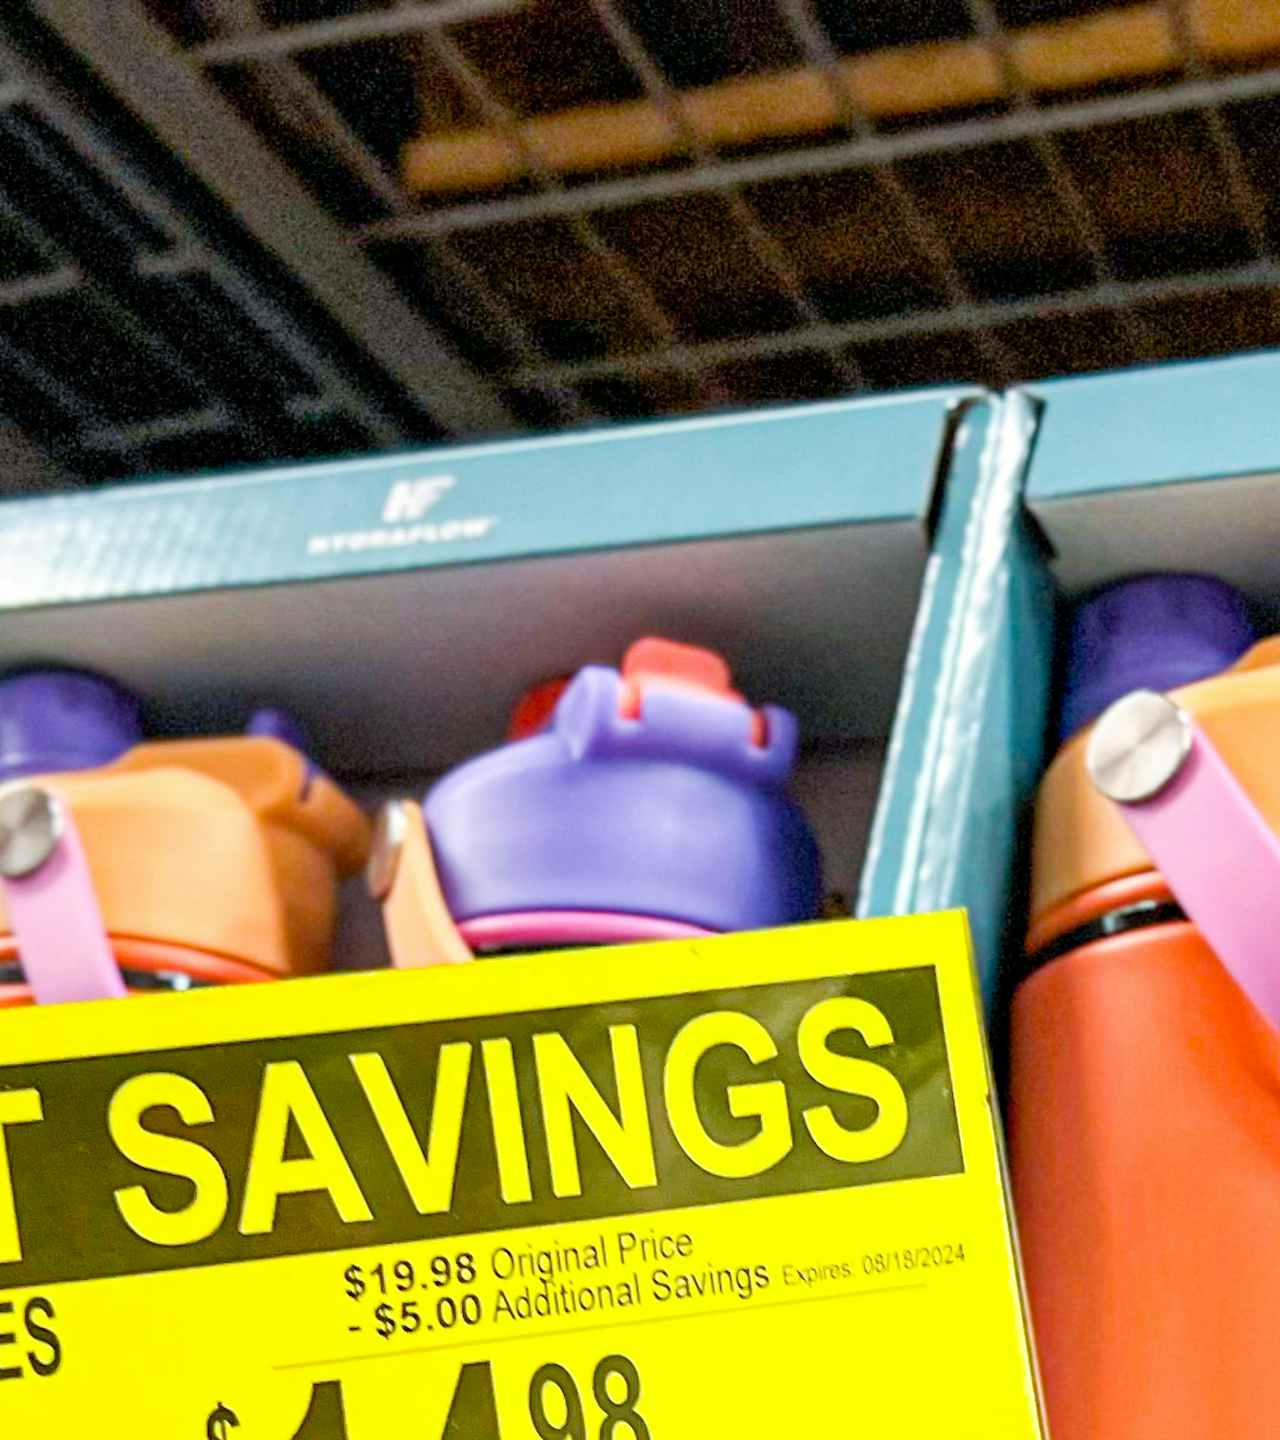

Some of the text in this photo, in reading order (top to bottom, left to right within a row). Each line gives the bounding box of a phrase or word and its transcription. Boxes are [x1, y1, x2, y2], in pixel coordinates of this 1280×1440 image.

[107, 996, 910, 1247] SAVINGS
[343, 1230, 695, 1301] $19.98 Original Price
[375, 1294, 483, 1340] $5.00
[492, 1272, 642, 1324] Additional
[652, 1262, 771, 1301] Savings
[862, 1243, 967, 1275] 08/18/2024
